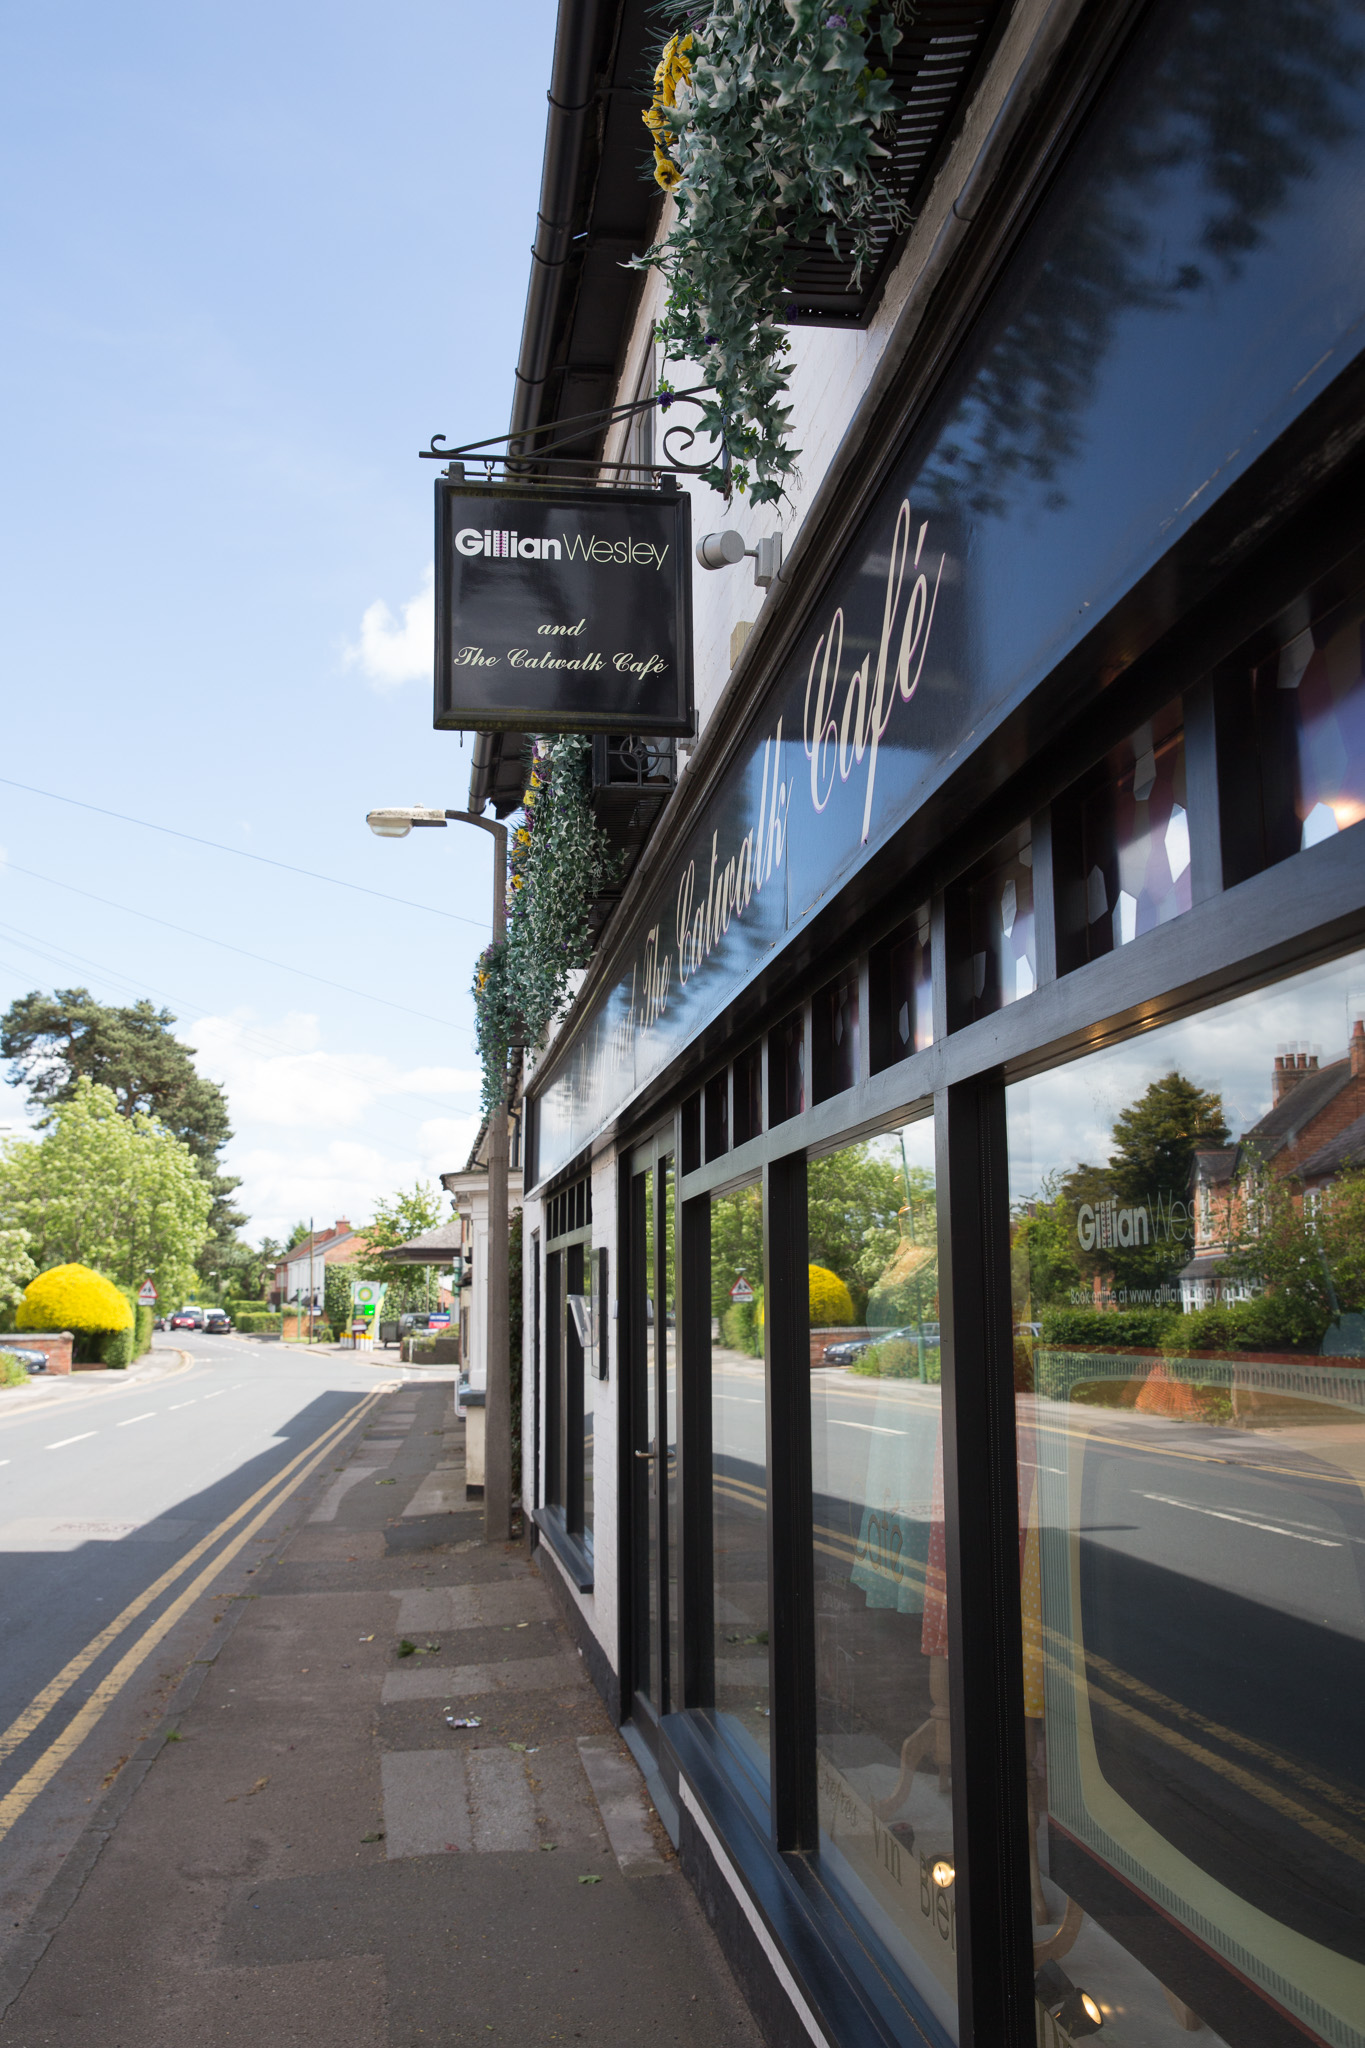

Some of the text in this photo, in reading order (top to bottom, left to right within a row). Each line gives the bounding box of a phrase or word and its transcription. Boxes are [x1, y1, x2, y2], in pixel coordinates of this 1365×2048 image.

[455, 528, 669, 571] Gillian Wesley
[537, 618, 587, 636] and
[454, 646, 669, 680] The Catwalk Café
[639, 923, 673, 1038] The
[677, 715, 793, 987] Catwalk
[804, 498, 946, 845] Café
[1077, 1199, 1150, 1251] Gillian
[1070, 1287, 1091, 1305] Book
[1092, 1286, 1117, 1305] online
[1119, 1285, 1128, 1304] at
